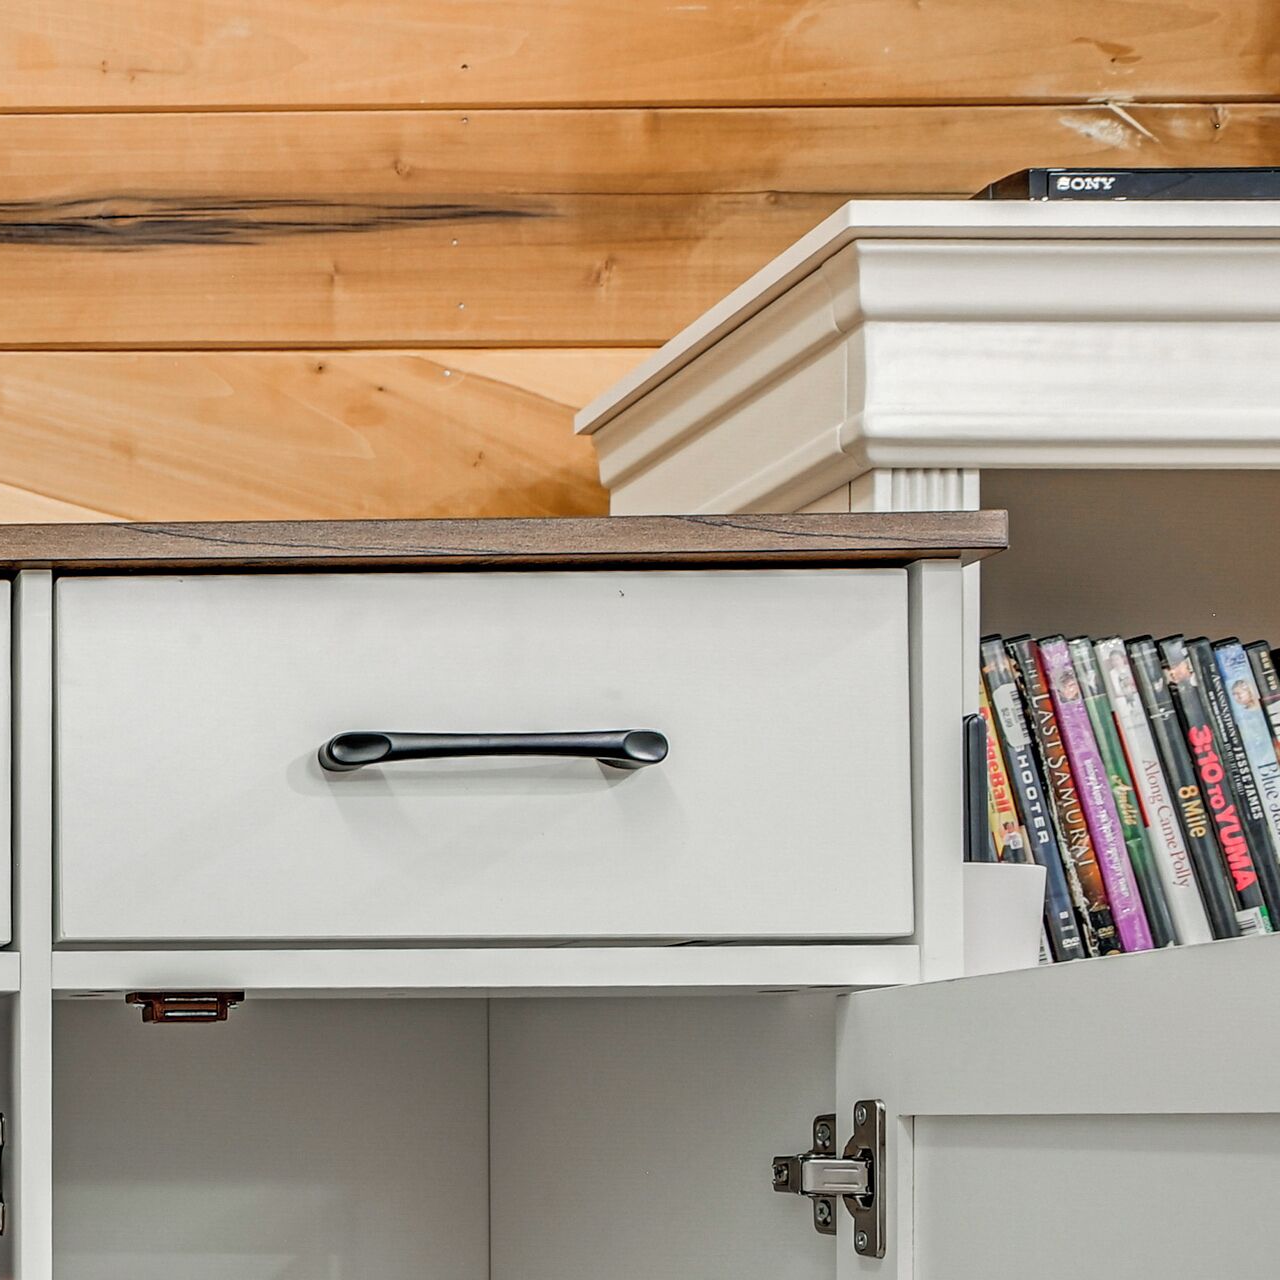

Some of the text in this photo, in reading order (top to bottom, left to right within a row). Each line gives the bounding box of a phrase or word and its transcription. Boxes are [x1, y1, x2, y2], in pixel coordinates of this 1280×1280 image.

[1057, 177, 1116, 190] SONY
[1024, 659, 1093, 866] THE LAST SAMURAI
[1188, 724, 1225, 784] 3:10
[1233, 747, 1252, 783] JESSE
[1245, 784, 1263, 819] JAMES
[1014, 744, 1049, 844] SHOOTER
[1142, 760, 1191, 888] Along Came Polly
[1178, 785, 1207, 838] 8 Mile
[1207, 785, 1226, 809] TO
[1215, 804, 1257, 892] YUMA
